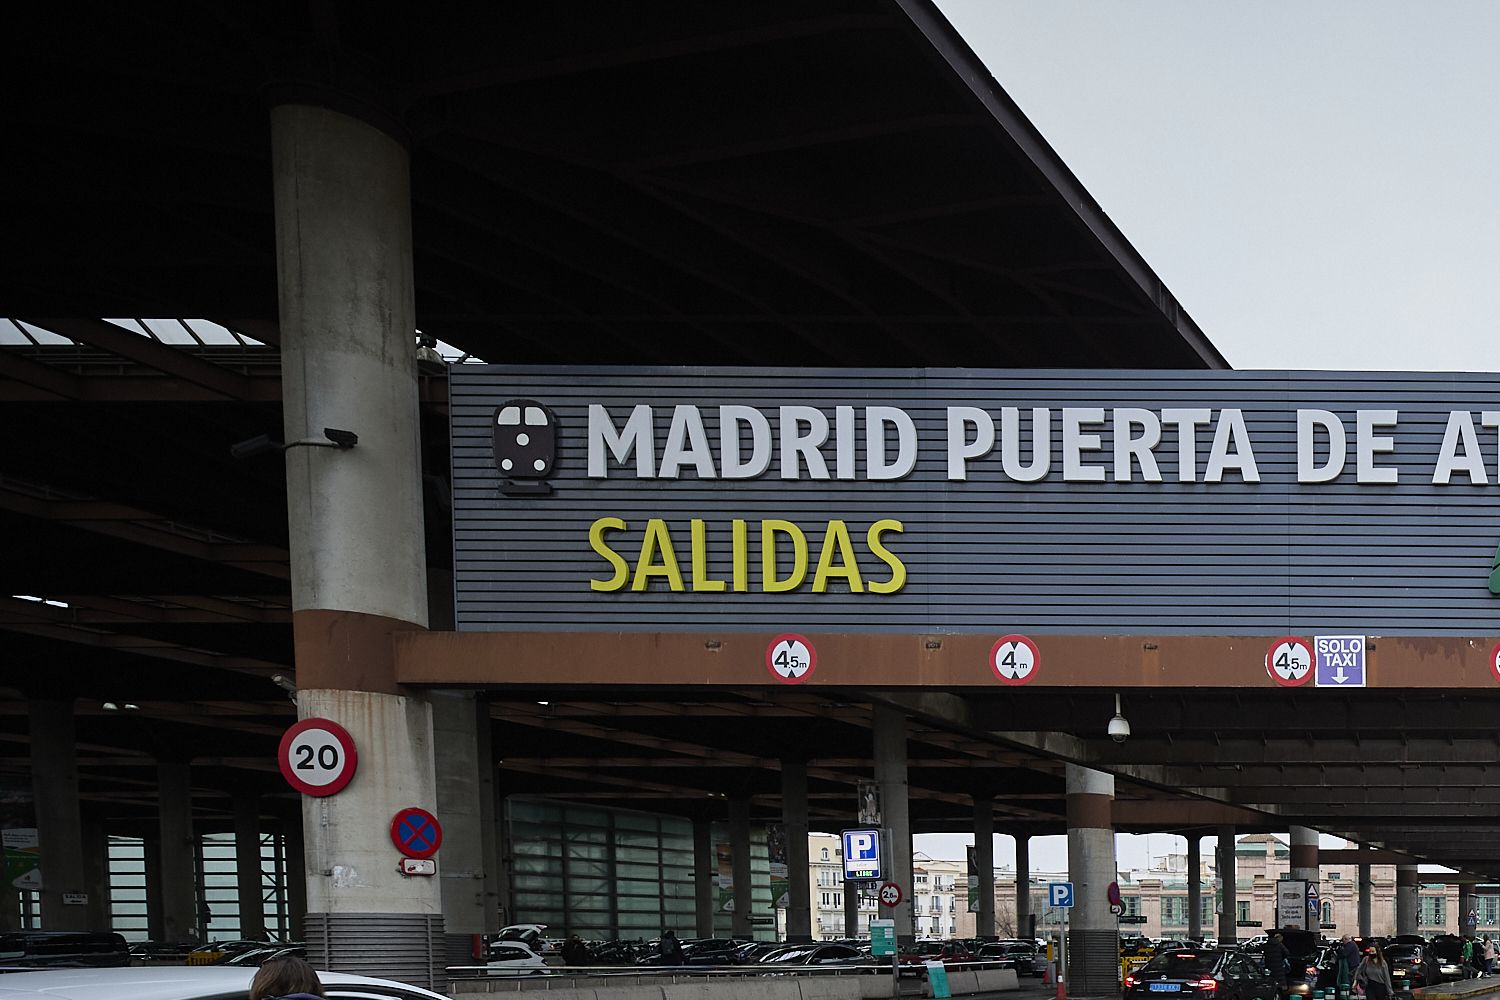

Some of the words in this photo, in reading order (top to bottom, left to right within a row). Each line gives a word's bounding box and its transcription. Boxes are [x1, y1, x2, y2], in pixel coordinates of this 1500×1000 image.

[587, 403, 918, 481] MADRID
[946, 405, 1261, 483] PUERTA
[1296, 408, 1399, 485] DE
[588, 516, 908, 595] SALIDAS
[1318, 639, 1362, 653] SOLO
[1323, 653, 1357, 667] TAXI
[295, 744, 340, 772] 20
[850, 834, 872, 859] P
[1053, 885, 1069, 905] P
